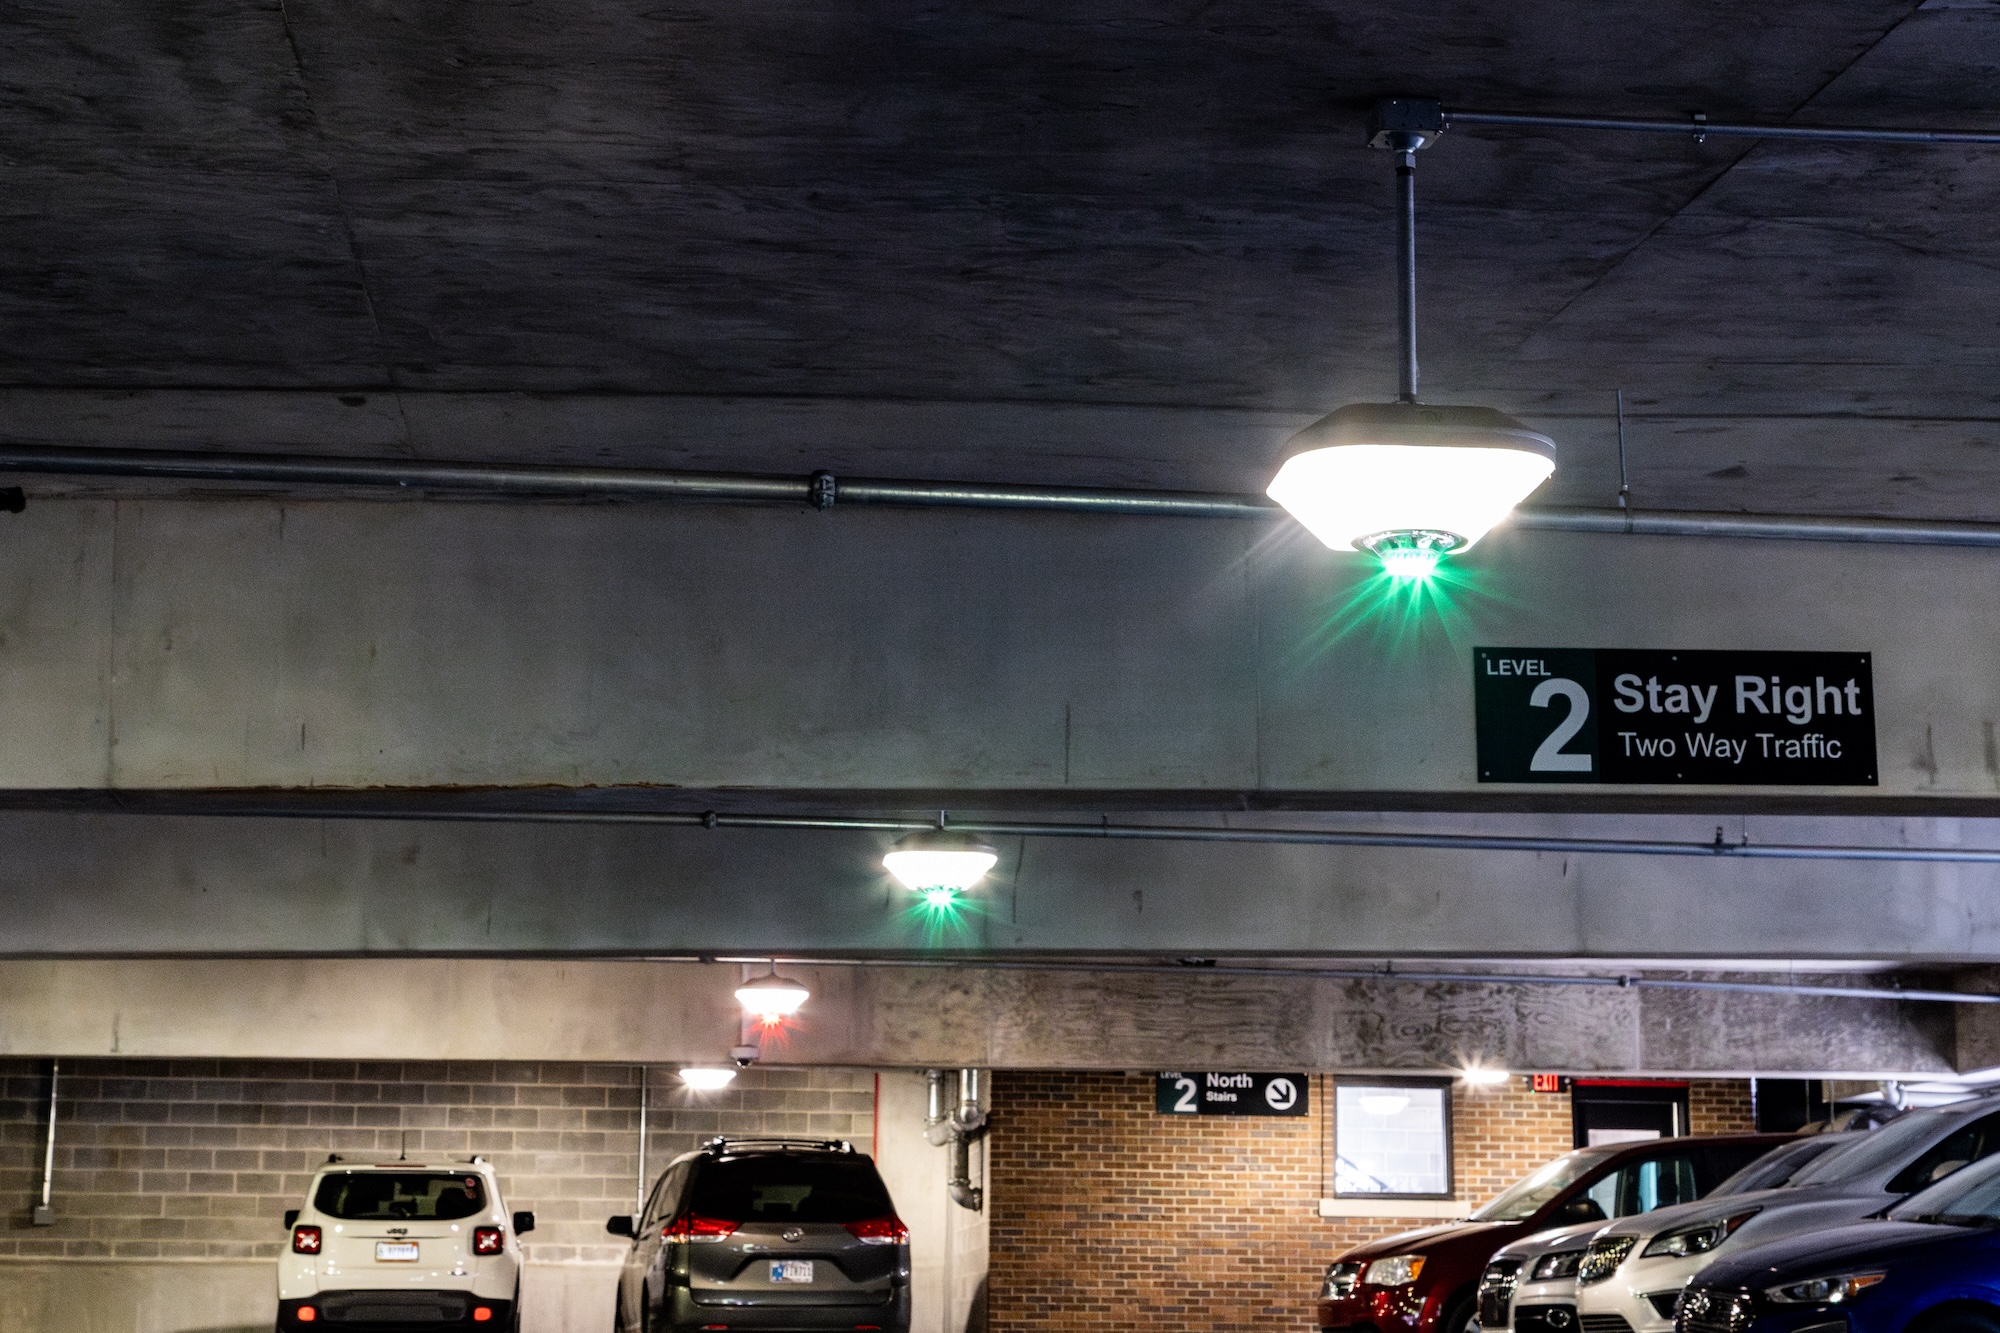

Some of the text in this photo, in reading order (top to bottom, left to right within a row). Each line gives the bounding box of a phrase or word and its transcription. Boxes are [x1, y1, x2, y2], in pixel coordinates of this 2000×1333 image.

[1486, 659, 1551, 676] LEVEL
[1613, 673, 1862, 724] Stay Right
[1529, 678, 1592, 771] 2
[1617, 732, 1842, 764] Two Way Traffic
[1206, 1072, 1253, 1088] North
[1533, 1073, 1559, 1091] EXIT
[1173, 1078, 1197, 1112] 2
[1206, 1091, 1238, 1102] Stairs
